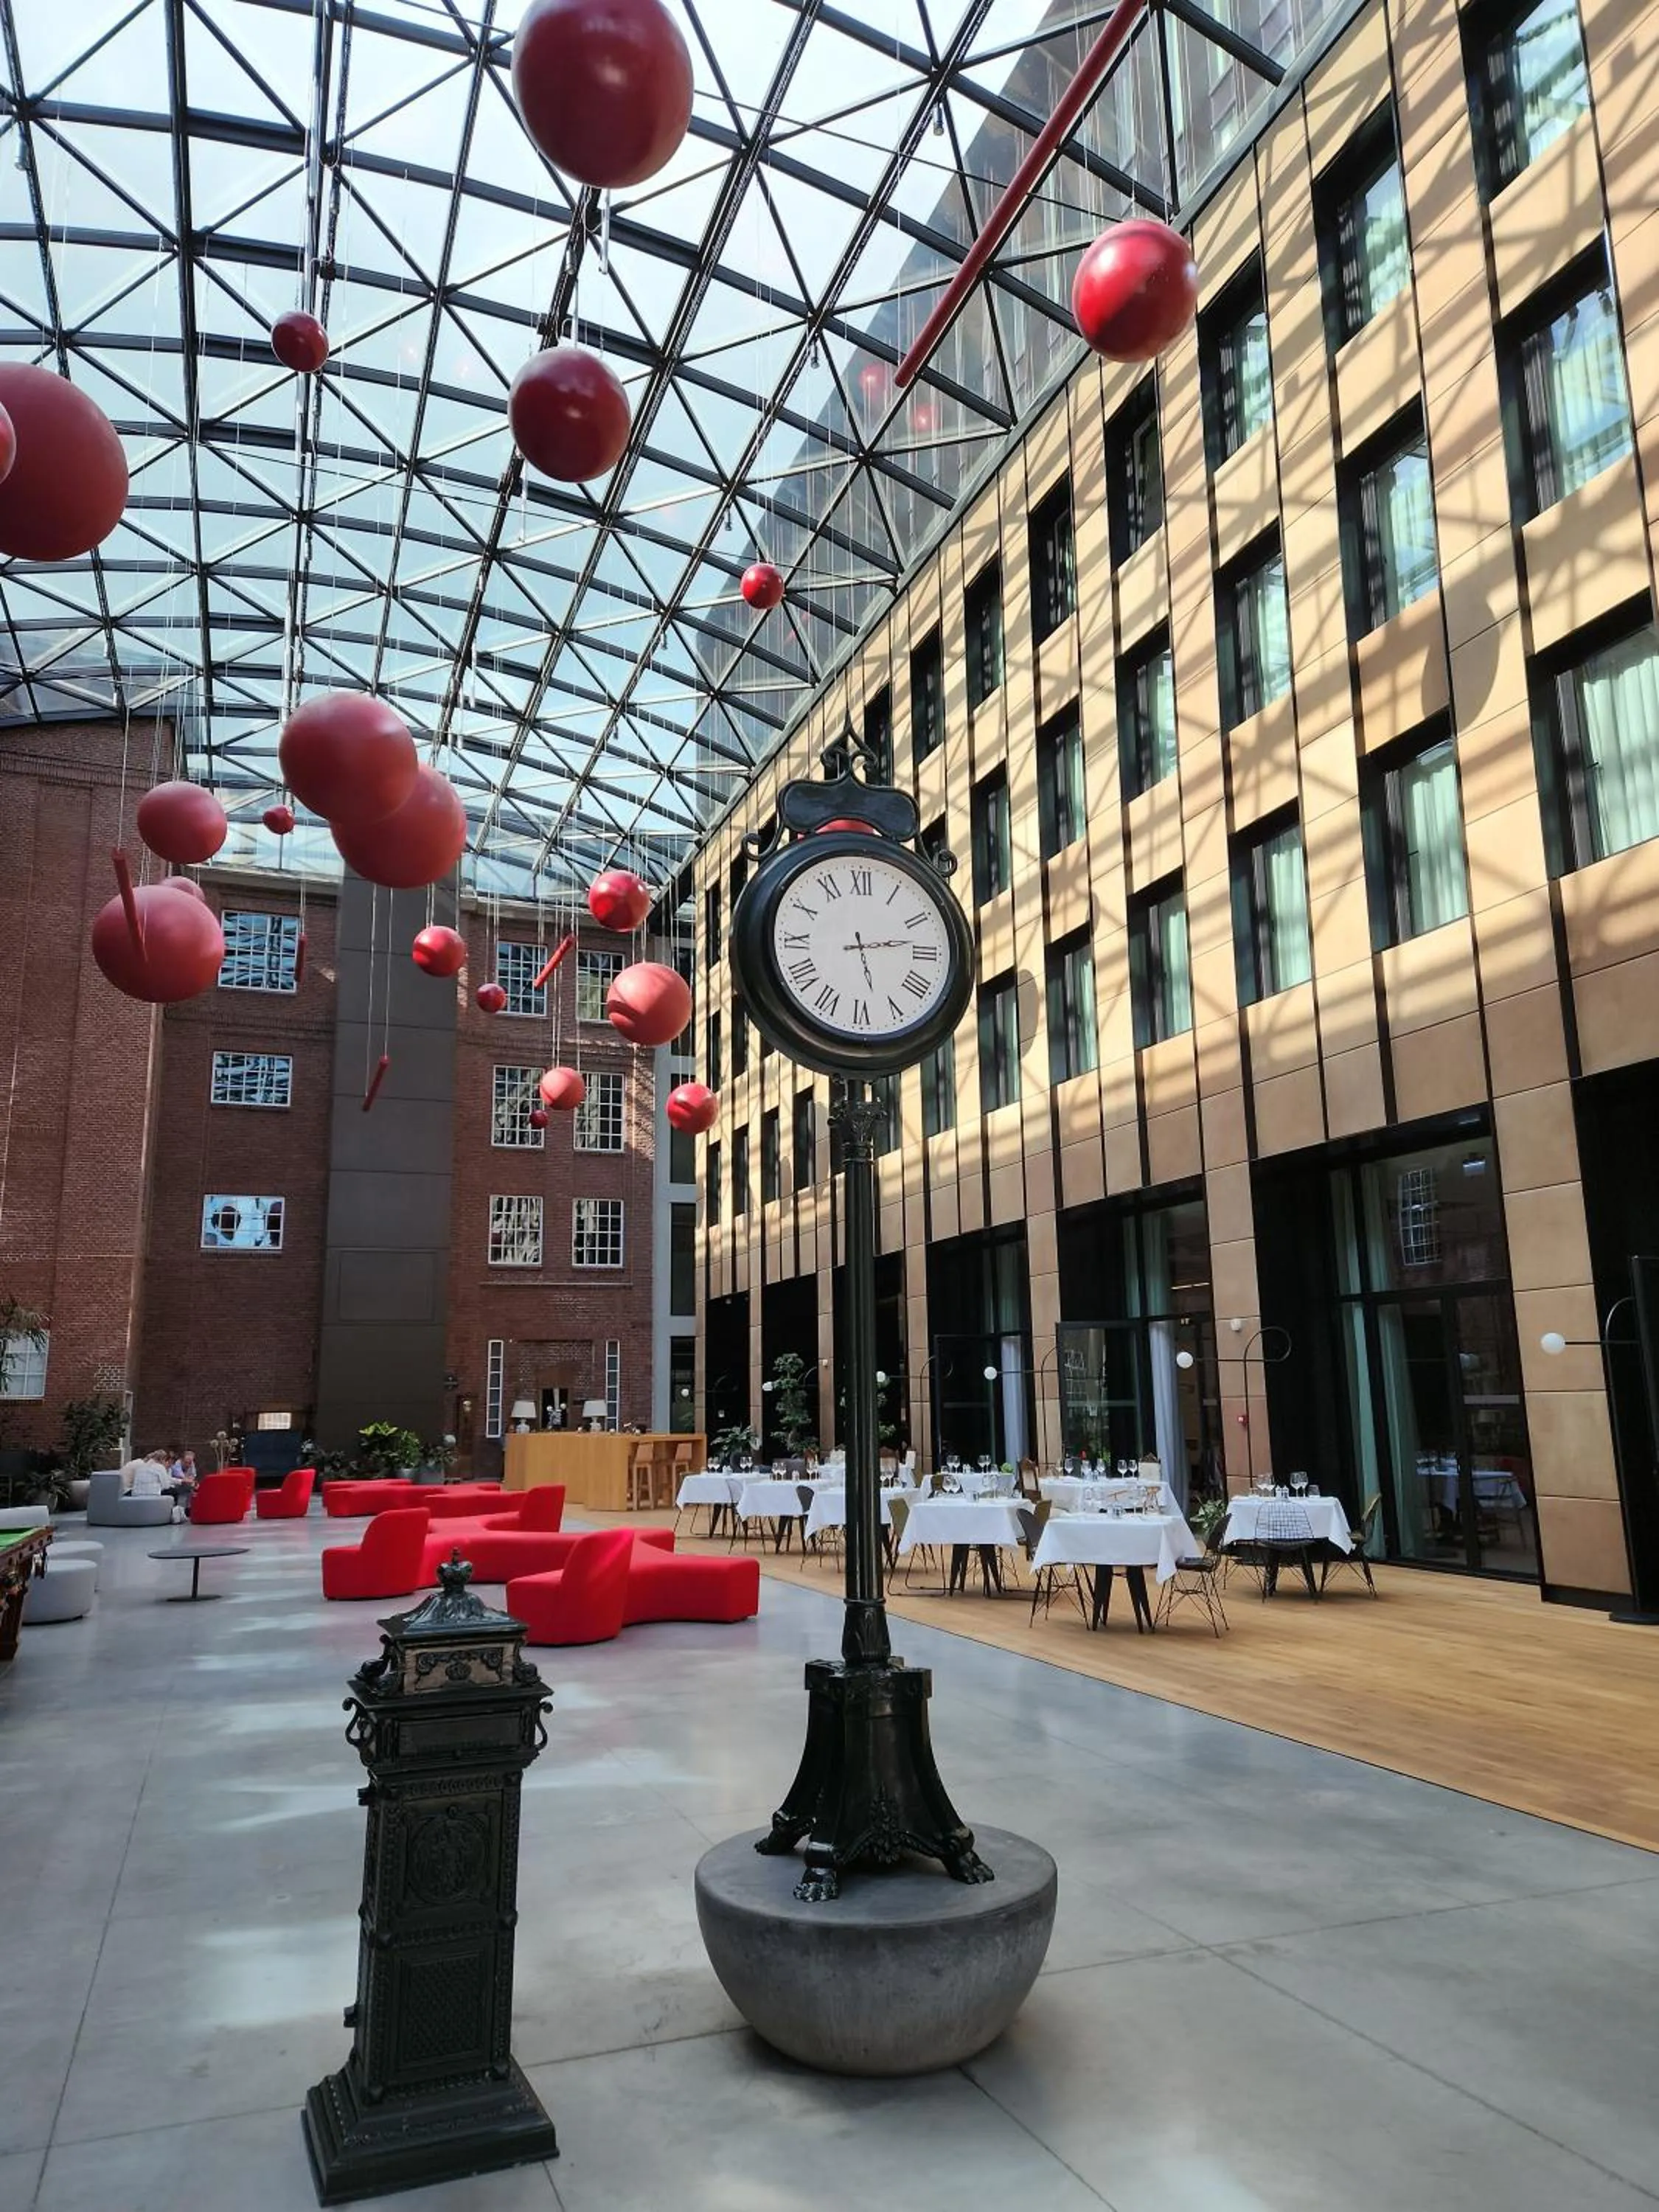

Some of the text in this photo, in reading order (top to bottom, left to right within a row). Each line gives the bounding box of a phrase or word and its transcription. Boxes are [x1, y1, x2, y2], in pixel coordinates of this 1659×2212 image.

[817, 874, 842, 902] XI
[850, 869, 872, 897] XII
[886, 884, 900, 905] I
[793, 898, 818, 921] X
[904, 912, 928, 930] II
[784, 932, 810, 950] IX
[912, 945, 937, 961] III
[788, 958, 820, 992] VIII
[901, 970, 931, 999] IIII
[814, 984, 841, 1017] VII
[852, 998, 871, 1026] VI
[887, 995, 904, 1020] V
